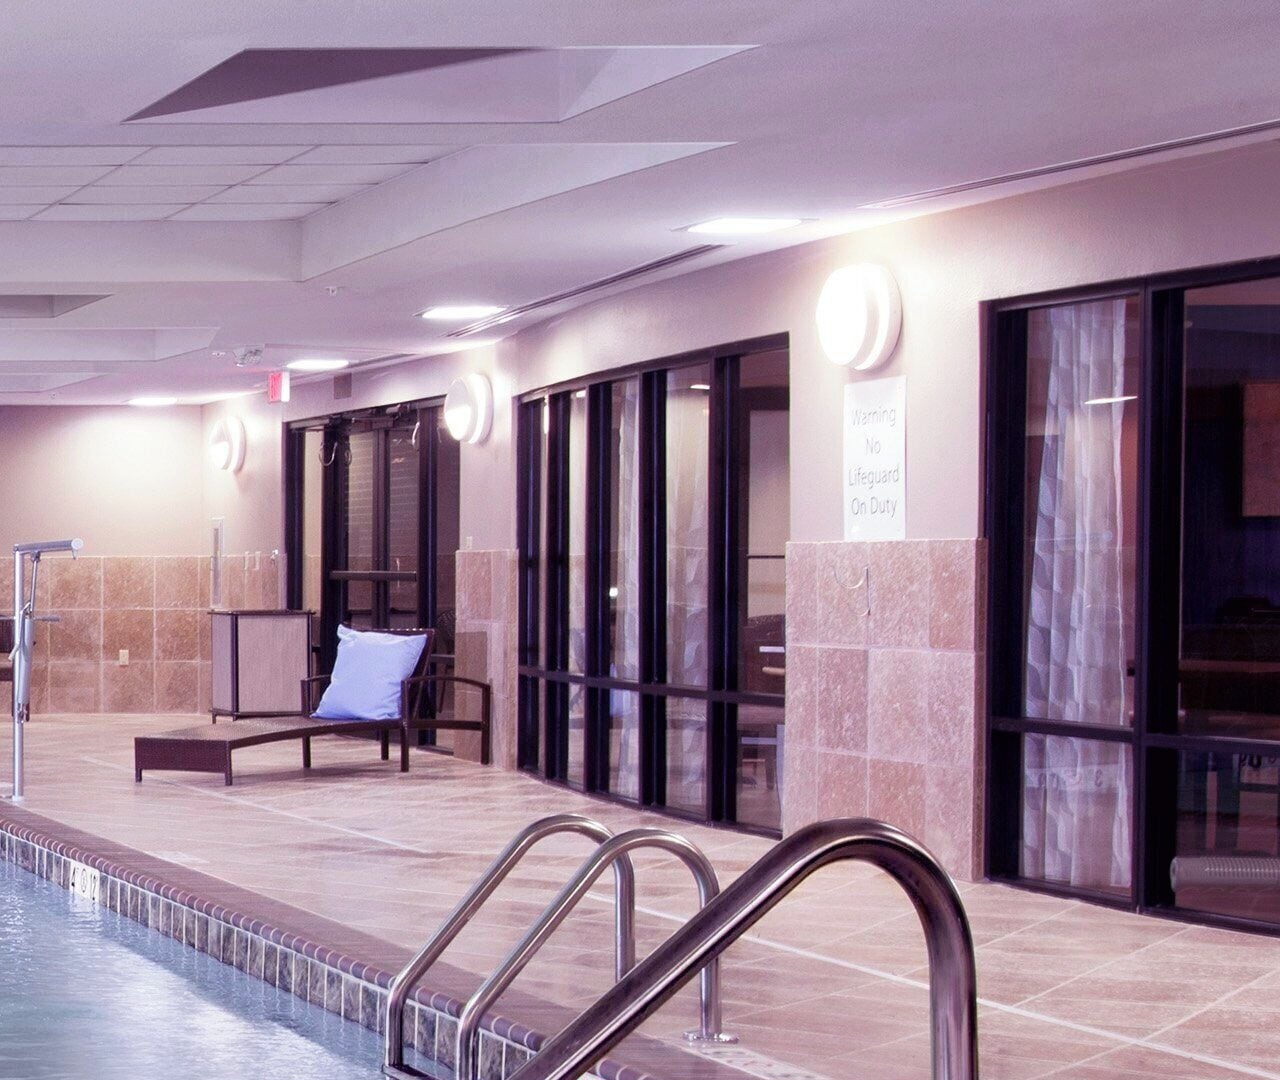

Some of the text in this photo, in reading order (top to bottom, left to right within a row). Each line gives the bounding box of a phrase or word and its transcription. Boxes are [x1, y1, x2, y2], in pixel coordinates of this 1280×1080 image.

[852, 406, 896, 427] Warning
[865, 438, 881, 455] No
[848, 464, 900, 489] Lifeguard
[851, 496, 897, 518] On Duty
